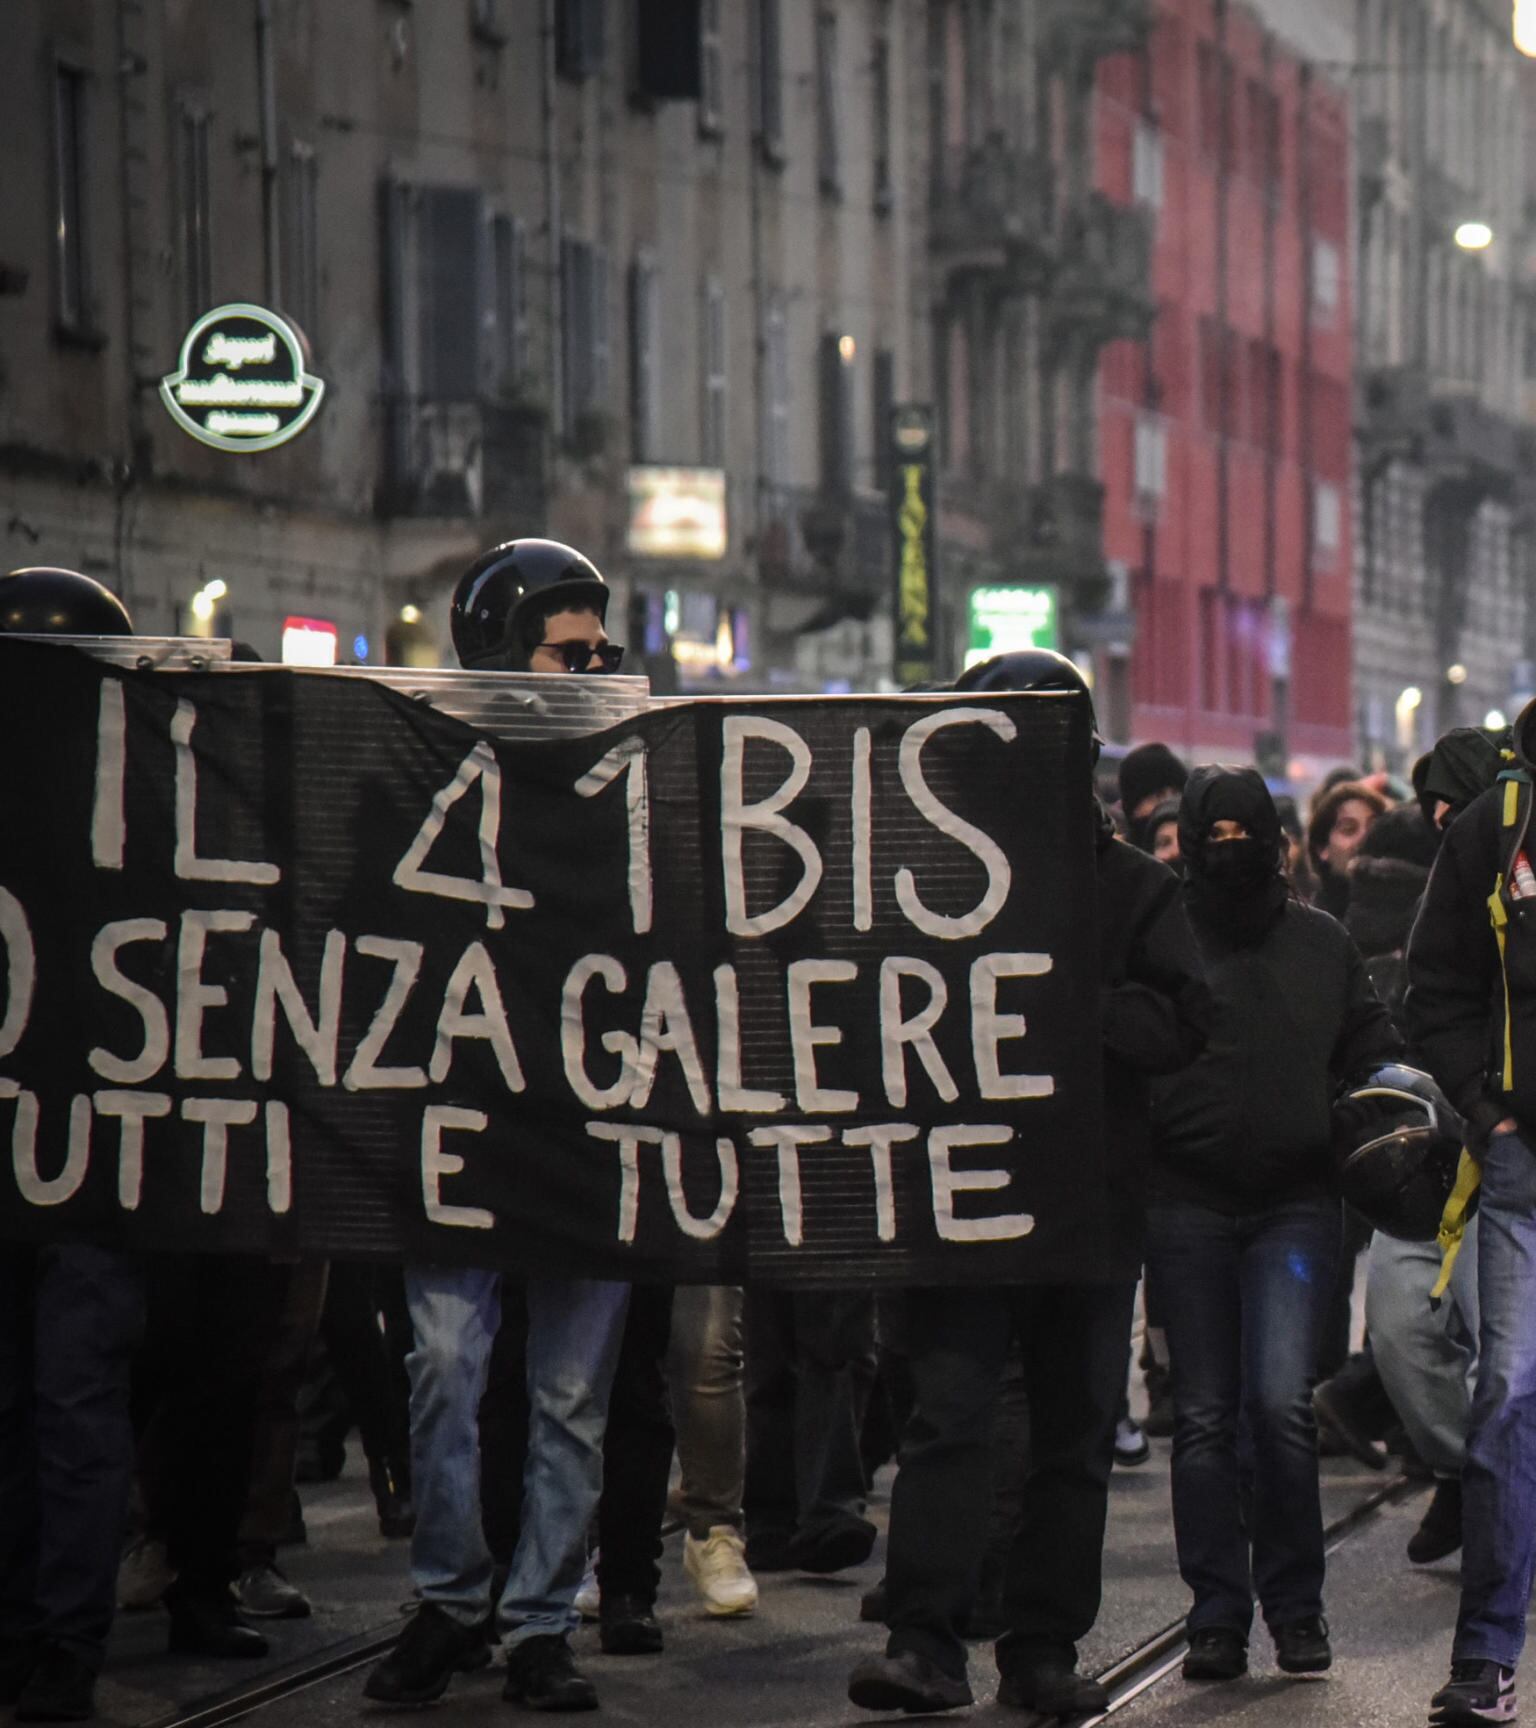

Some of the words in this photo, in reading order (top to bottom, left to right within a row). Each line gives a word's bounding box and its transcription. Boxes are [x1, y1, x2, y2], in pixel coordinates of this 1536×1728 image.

[92, 678, 280, 884] IL
[393, 736, 653, 934] 41
[720, 707, 1017, 940] BIS
[88, 910, 525, 1092] SENZA
[561, 952, 1055, 1116] GALERE
[0, 1077, 291, 1214] UTTI
[421, 1105, 494, 1228] E
[586, 1121, 1035, 1246] TUTTE
